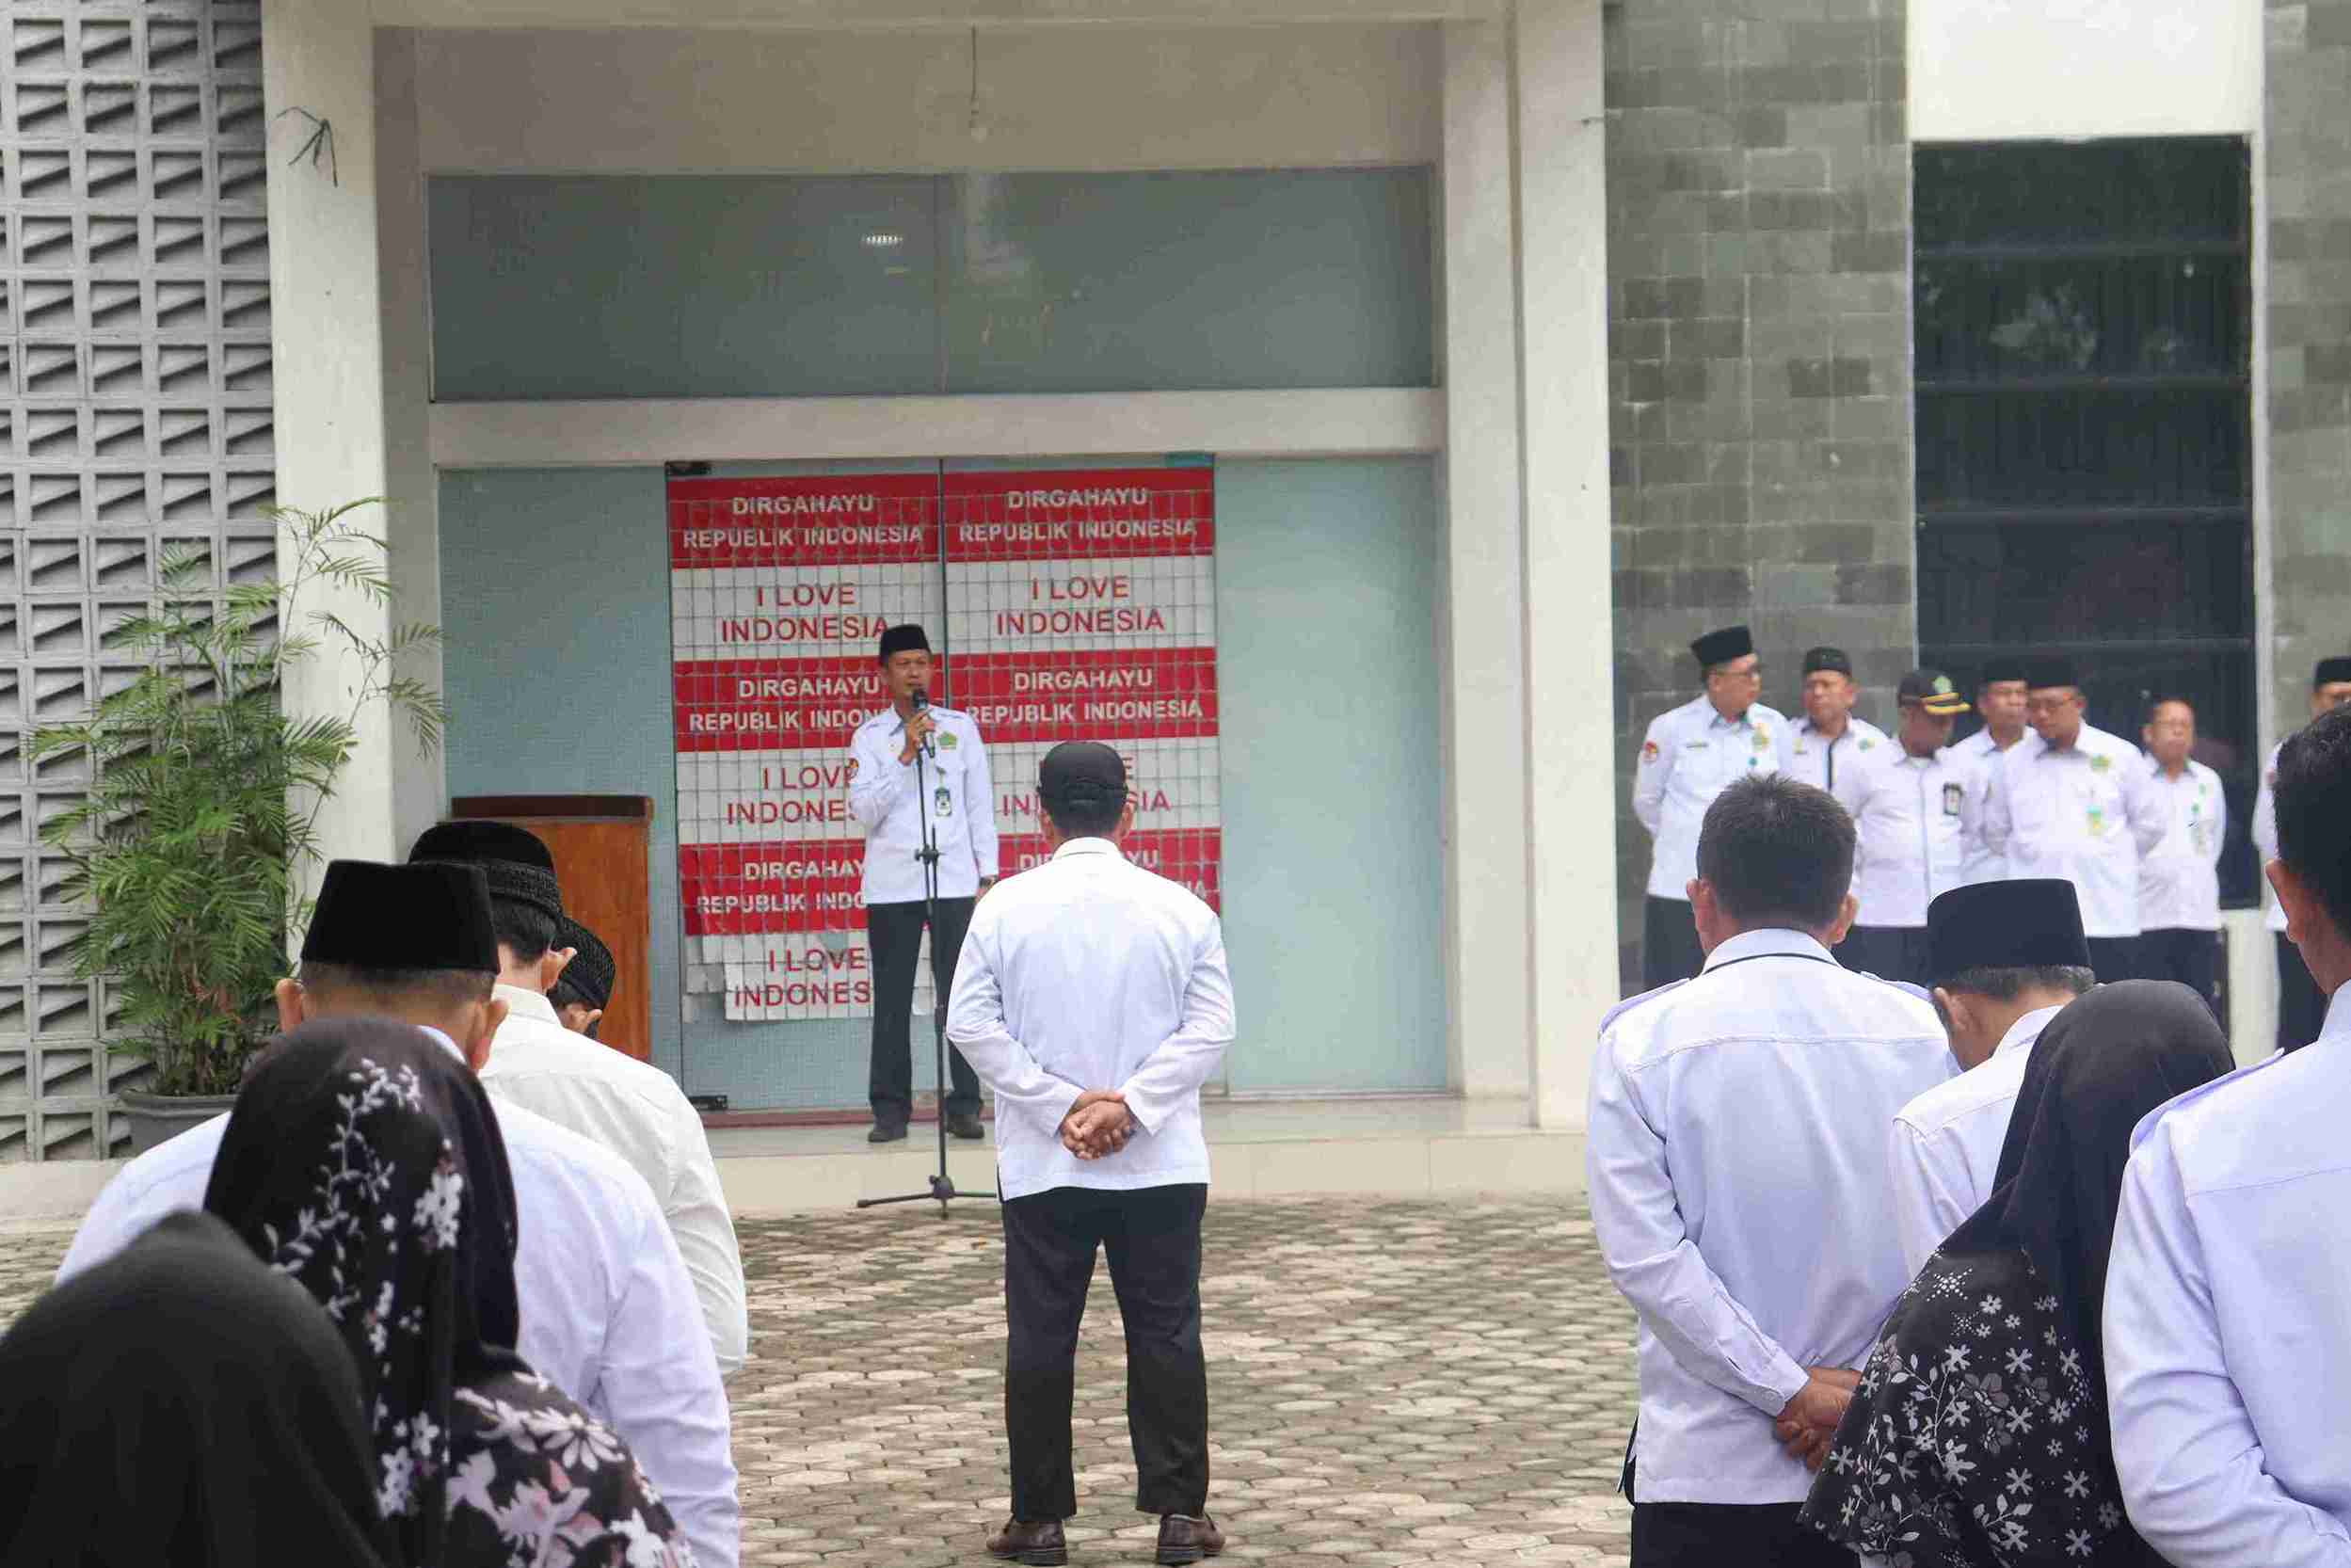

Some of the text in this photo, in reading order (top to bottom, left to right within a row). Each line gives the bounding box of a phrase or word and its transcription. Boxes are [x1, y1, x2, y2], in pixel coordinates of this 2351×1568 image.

[731, 495, 874, 515] DIRGAHAYU
[1007, 488, 1148, 509] DIRGAHAYU
[683, 526, 923, 548] REPUBLIK INDONESIA
[959, 519, 1197, 542] REPUBLIK INDONESIA
[758, 583, 856, 607] I LOVE
[1032, 575, 1128, 600] I LOVE
[722, 616, 888, 642] INDONESIA
[996, 608, 1165, 635] INDONESIA
[739, 676, 880, 697] DIRGAHAYU
[1015, 668, 1153, 691] DIRGAHAYU
[689, 711, 800, 731] REPUBLIK
[966, 699, 1204, 724] REPUBLIK INDONESIA
[763, 767, 769, 790] I
[744, 859, 865, 881] DIRGAHAY
[696, 895, 806, 915] REPUBLIK
[769, 947, 866, 972] I LOVE
[735, 981, 871, 1007] INDONES
